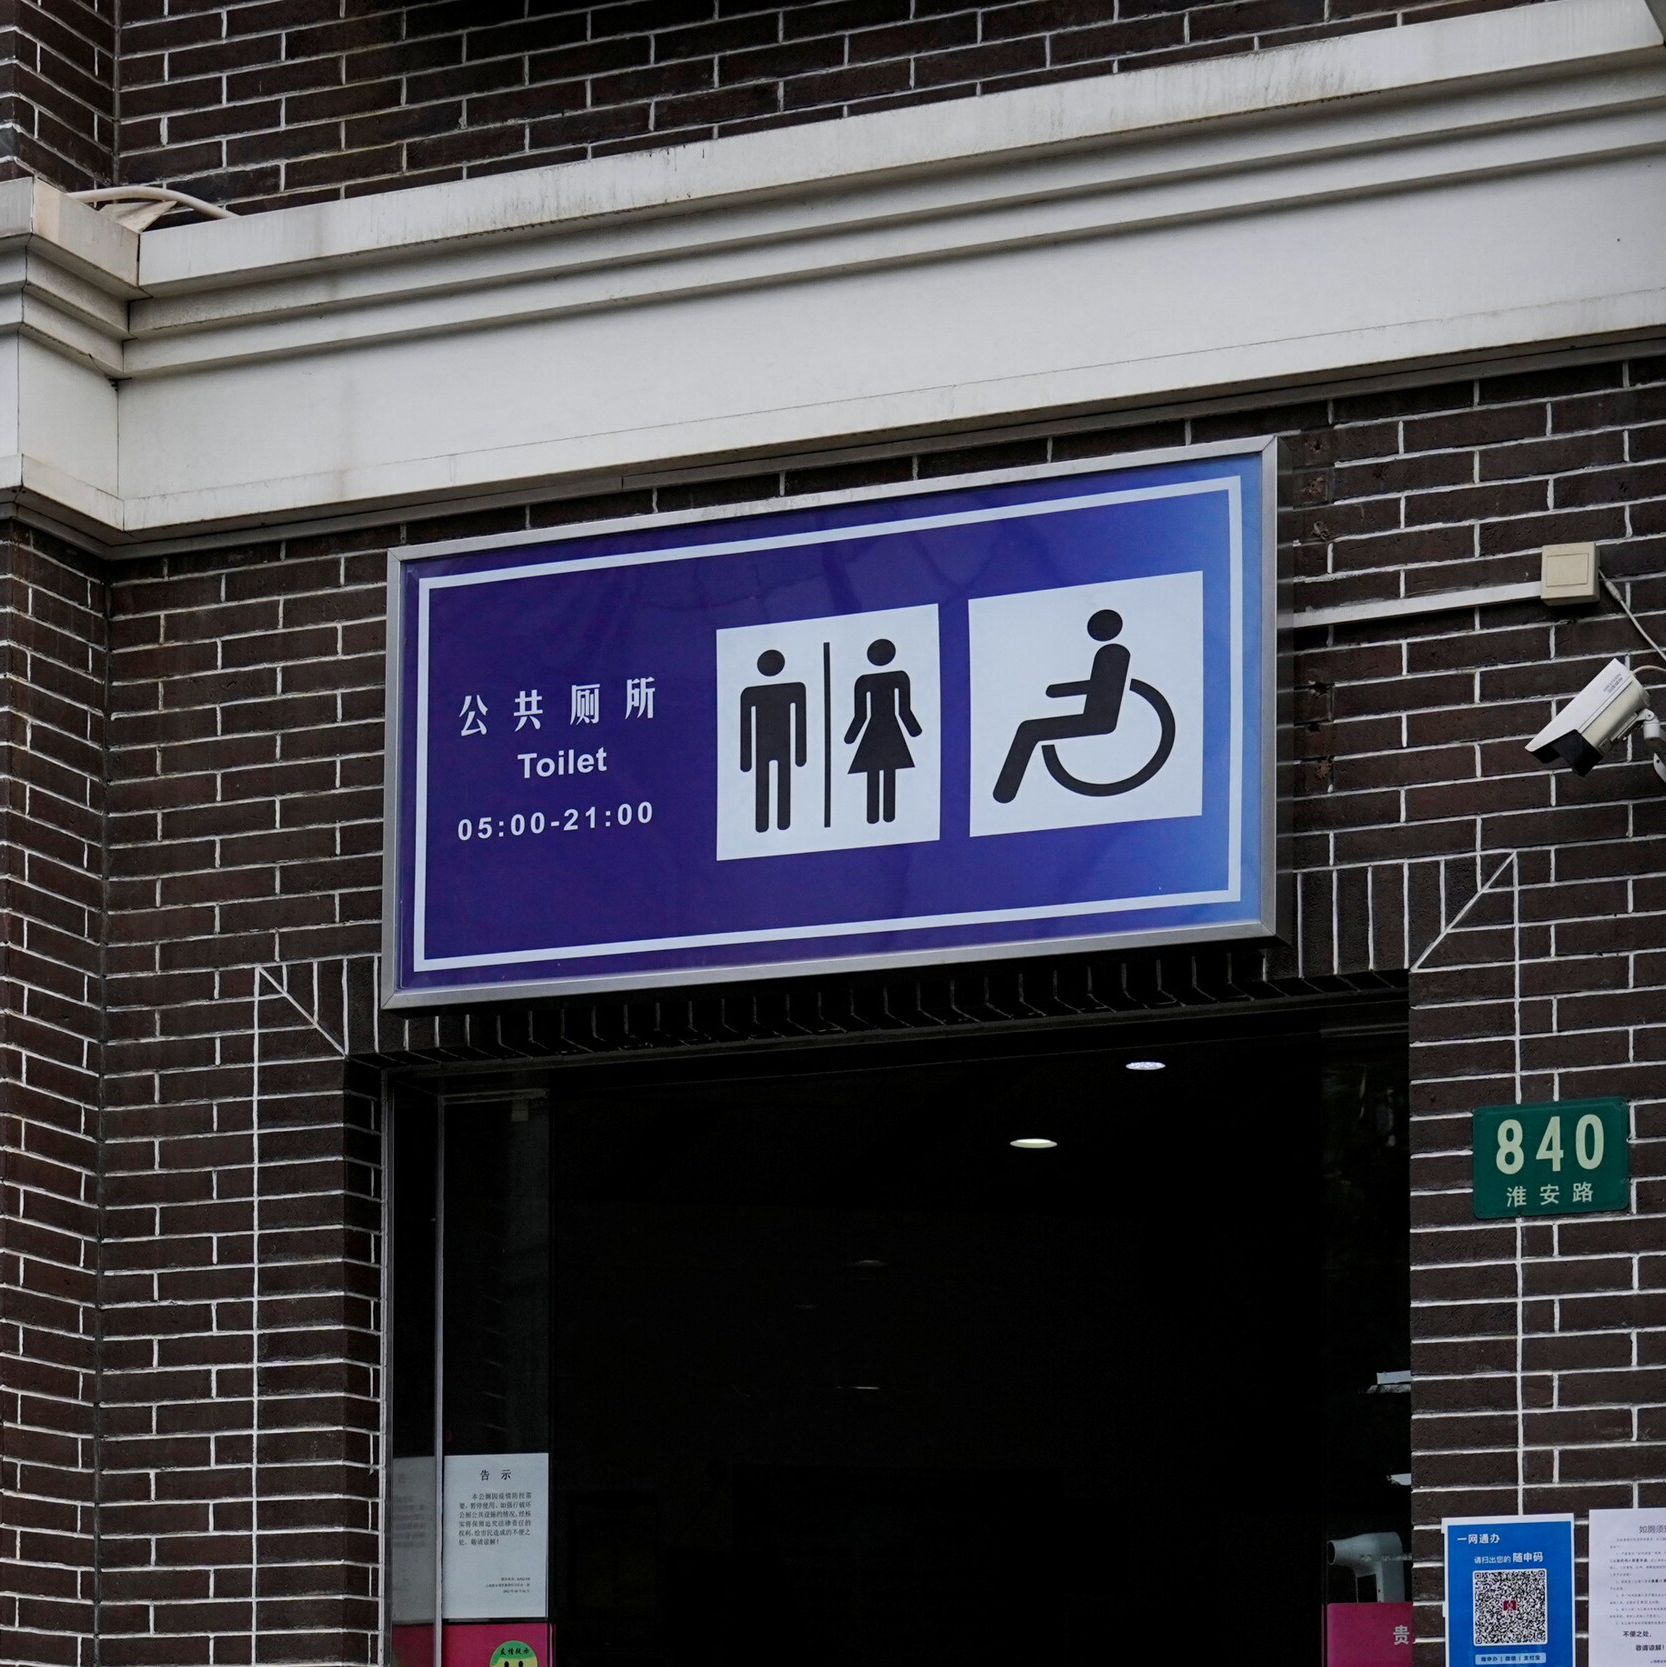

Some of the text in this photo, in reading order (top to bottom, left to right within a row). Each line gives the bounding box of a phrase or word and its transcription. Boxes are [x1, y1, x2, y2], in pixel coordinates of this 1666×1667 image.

[459, 677, 656, 736] 公共厕所
[517, 747, 607, 779] Toilet
[458, 801, 653, 841] 05:00-21:00
[1496, 1114, 1604, 1175] 840
[1506, 1182, 1594, 1208] 淮安路
[480, 1469, 512, 1481] 告示
[1457, 1533, 1500, 1545] 一网通办
[1393, 1625, 1410, 1646] 贵
